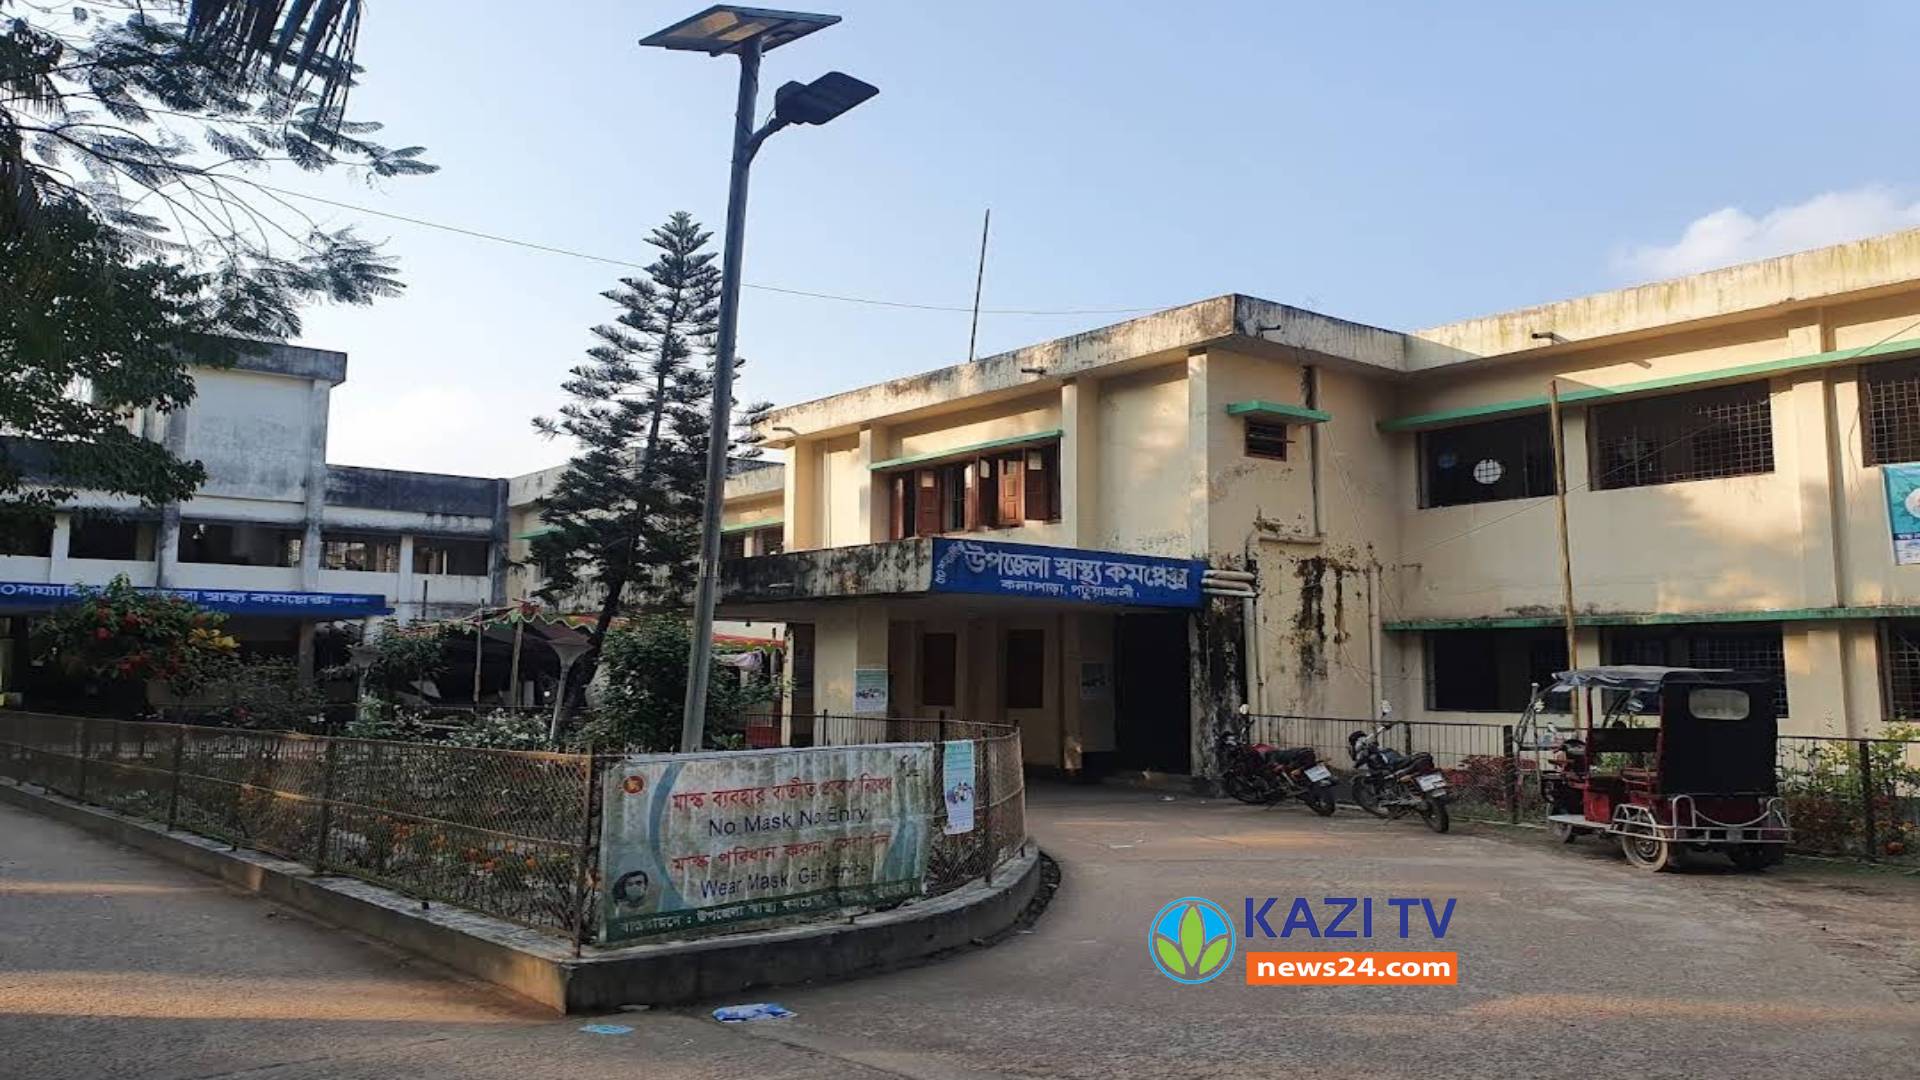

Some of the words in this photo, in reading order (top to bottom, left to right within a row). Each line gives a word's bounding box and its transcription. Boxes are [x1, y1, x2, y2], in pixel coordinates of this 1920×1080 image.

[963, 541, 1050, 579] উপজেলা
[1053, 557, 1102, 585] স্বাস্থ্য
[709, 819, 736, 837] No
[745, 811, 792, 832] Mask
[700, 880, 742, 899] Wear
